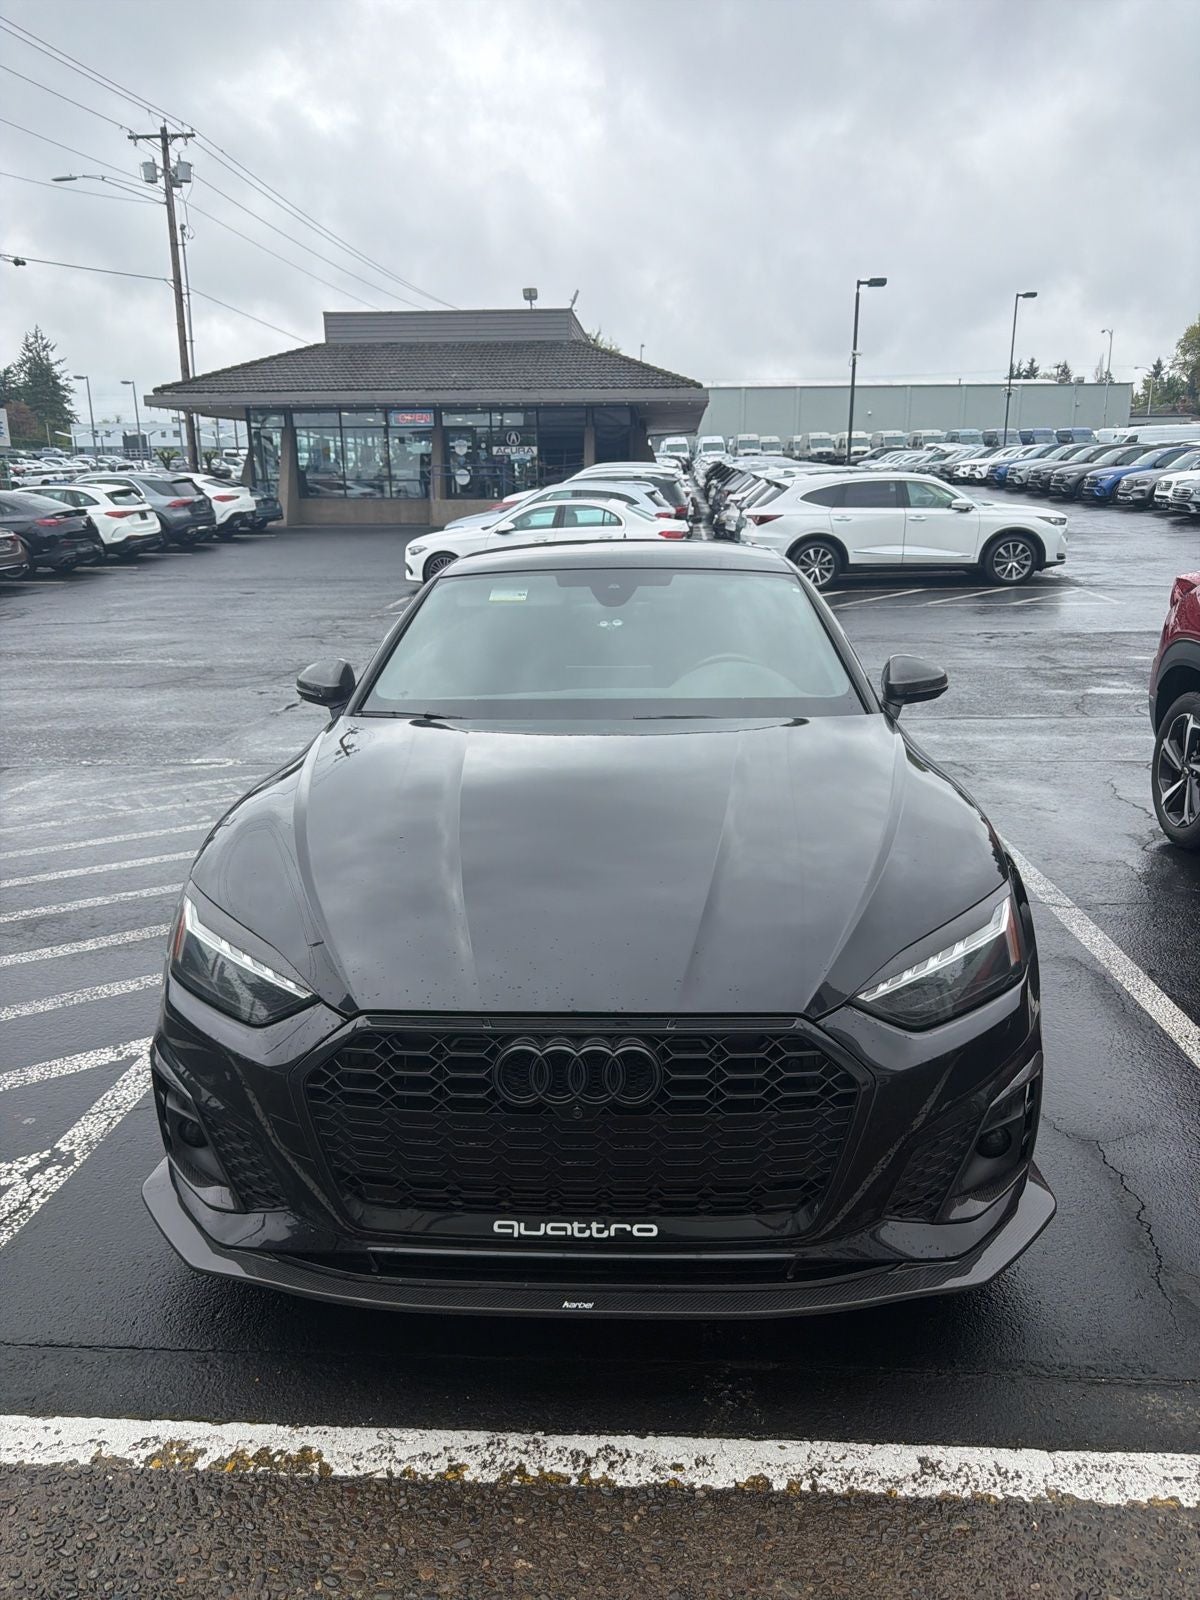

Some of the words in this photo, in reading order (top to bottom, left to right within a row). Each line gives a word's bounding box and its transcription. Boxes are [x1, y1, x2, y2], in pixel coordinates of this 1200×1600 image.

[399, 413, 430, 424] OPEN
[496, 447, 534, 455] ACURA
[493, 1220, 658, 1238] quattro
